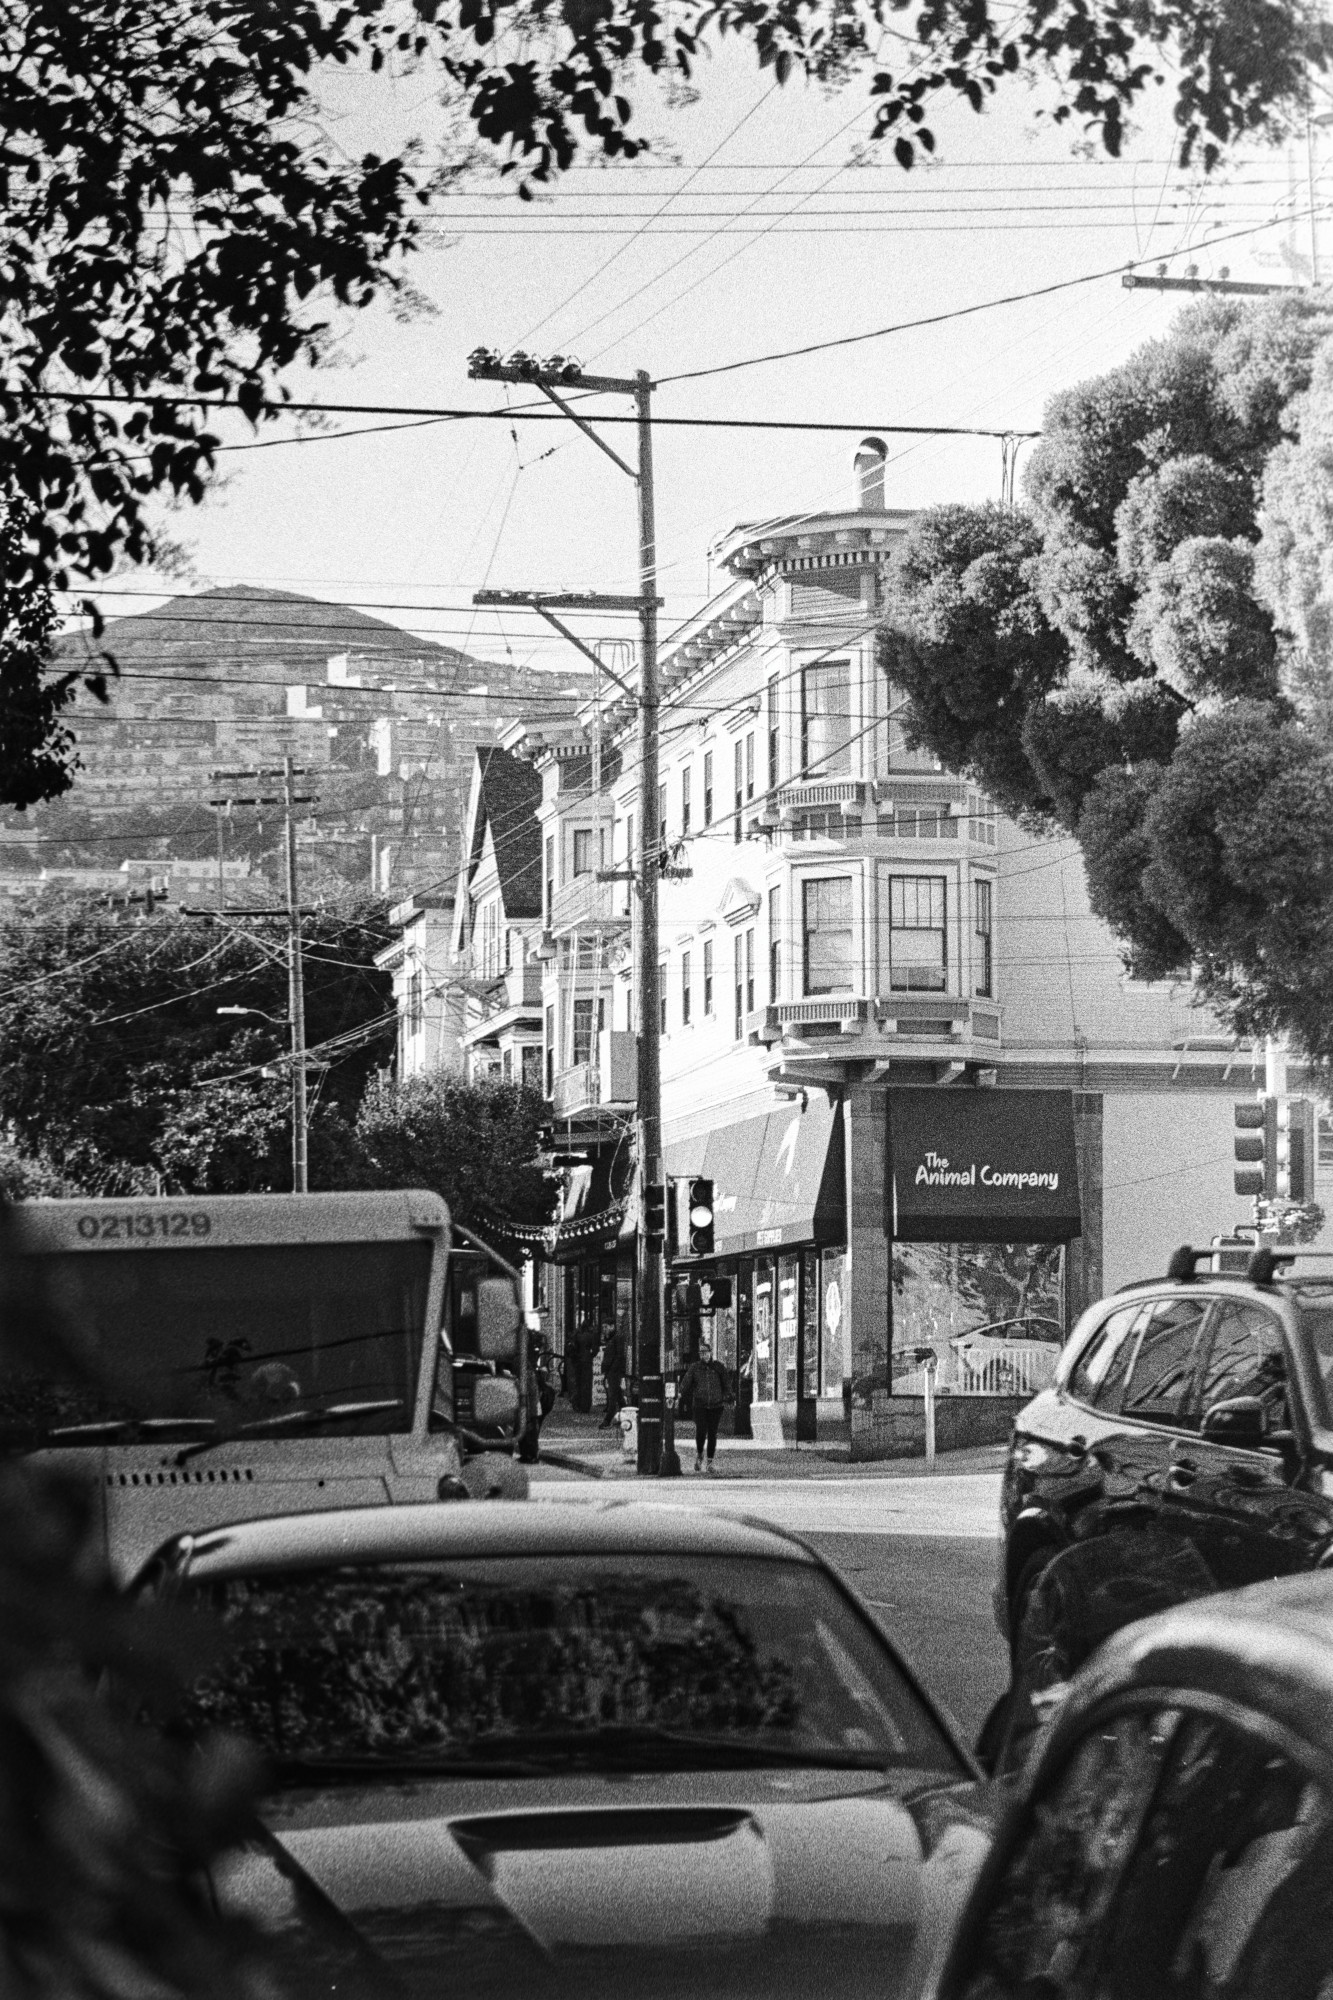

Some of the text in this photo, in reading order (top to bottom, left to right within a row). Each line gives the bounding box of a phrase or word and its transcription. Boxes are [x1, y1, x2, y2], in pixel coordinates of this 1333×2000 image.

[924, 1152, 950, 1168] The
[915, 1164, 1059, 1190] Animal Company
[77, 1212, 212, 1239] 0213129
